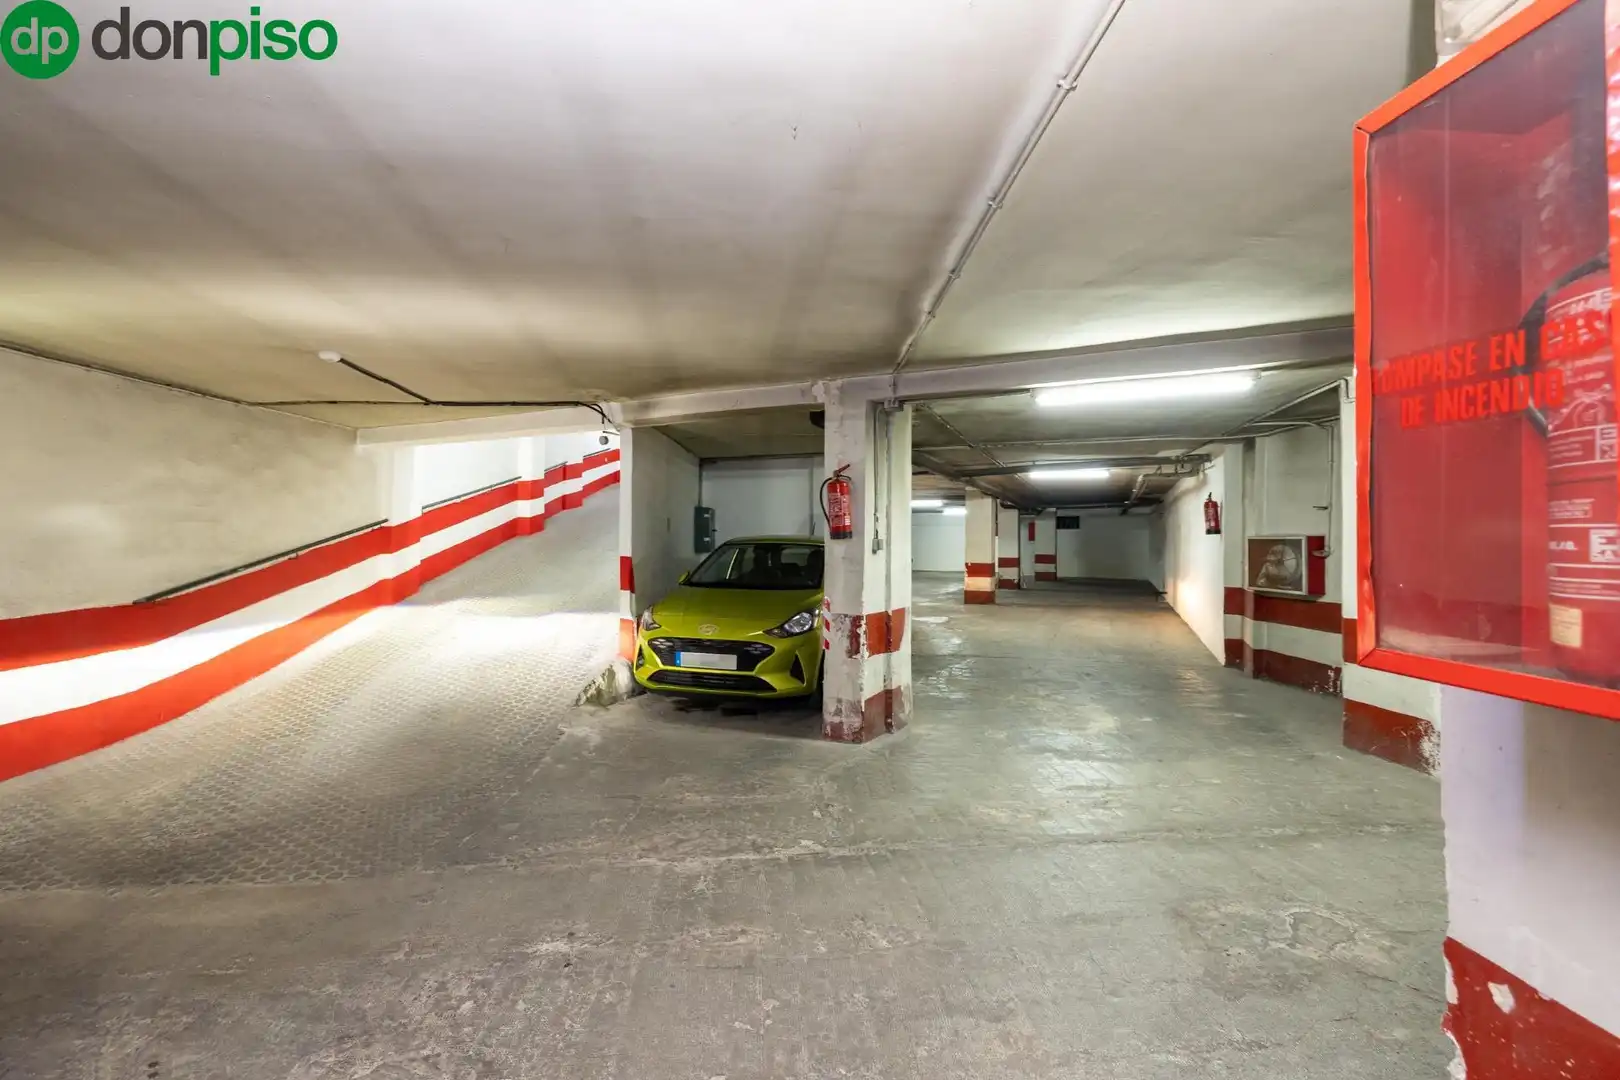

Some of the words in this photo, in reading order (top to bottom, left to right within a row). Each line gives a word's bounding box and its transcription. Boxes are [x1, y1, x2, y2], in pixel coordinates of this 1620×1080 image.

[1490, 329, 1526, 371] EN
[1400, 394, 1425, 429] DE
[1434, 369, 1566, 423] INCENDIO
